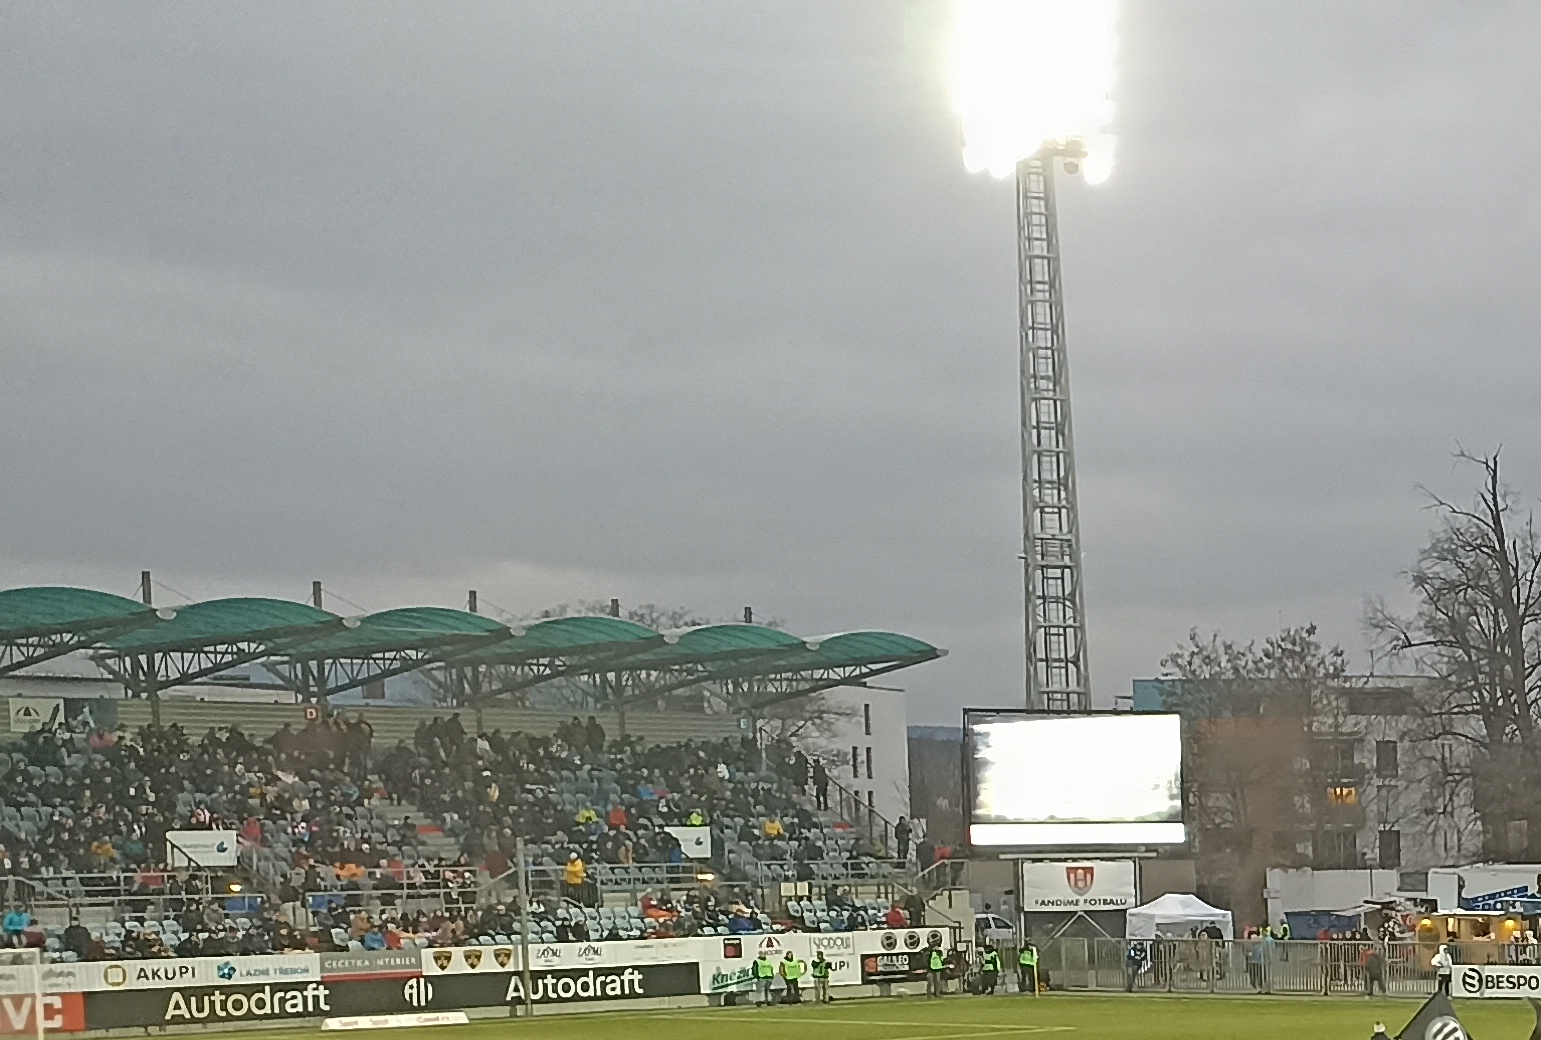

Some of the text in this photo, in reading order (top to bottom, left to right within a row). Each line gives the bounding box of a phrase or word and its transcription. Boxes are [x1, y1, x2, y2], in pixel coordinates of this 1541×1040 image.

[136, 965, 196, 981] AKUPI
[505, 968, 644, 1001] Autodraft
[1484, 974, 1540, 991] BESPO
[165, 982, 331, 1020] Autodraft
